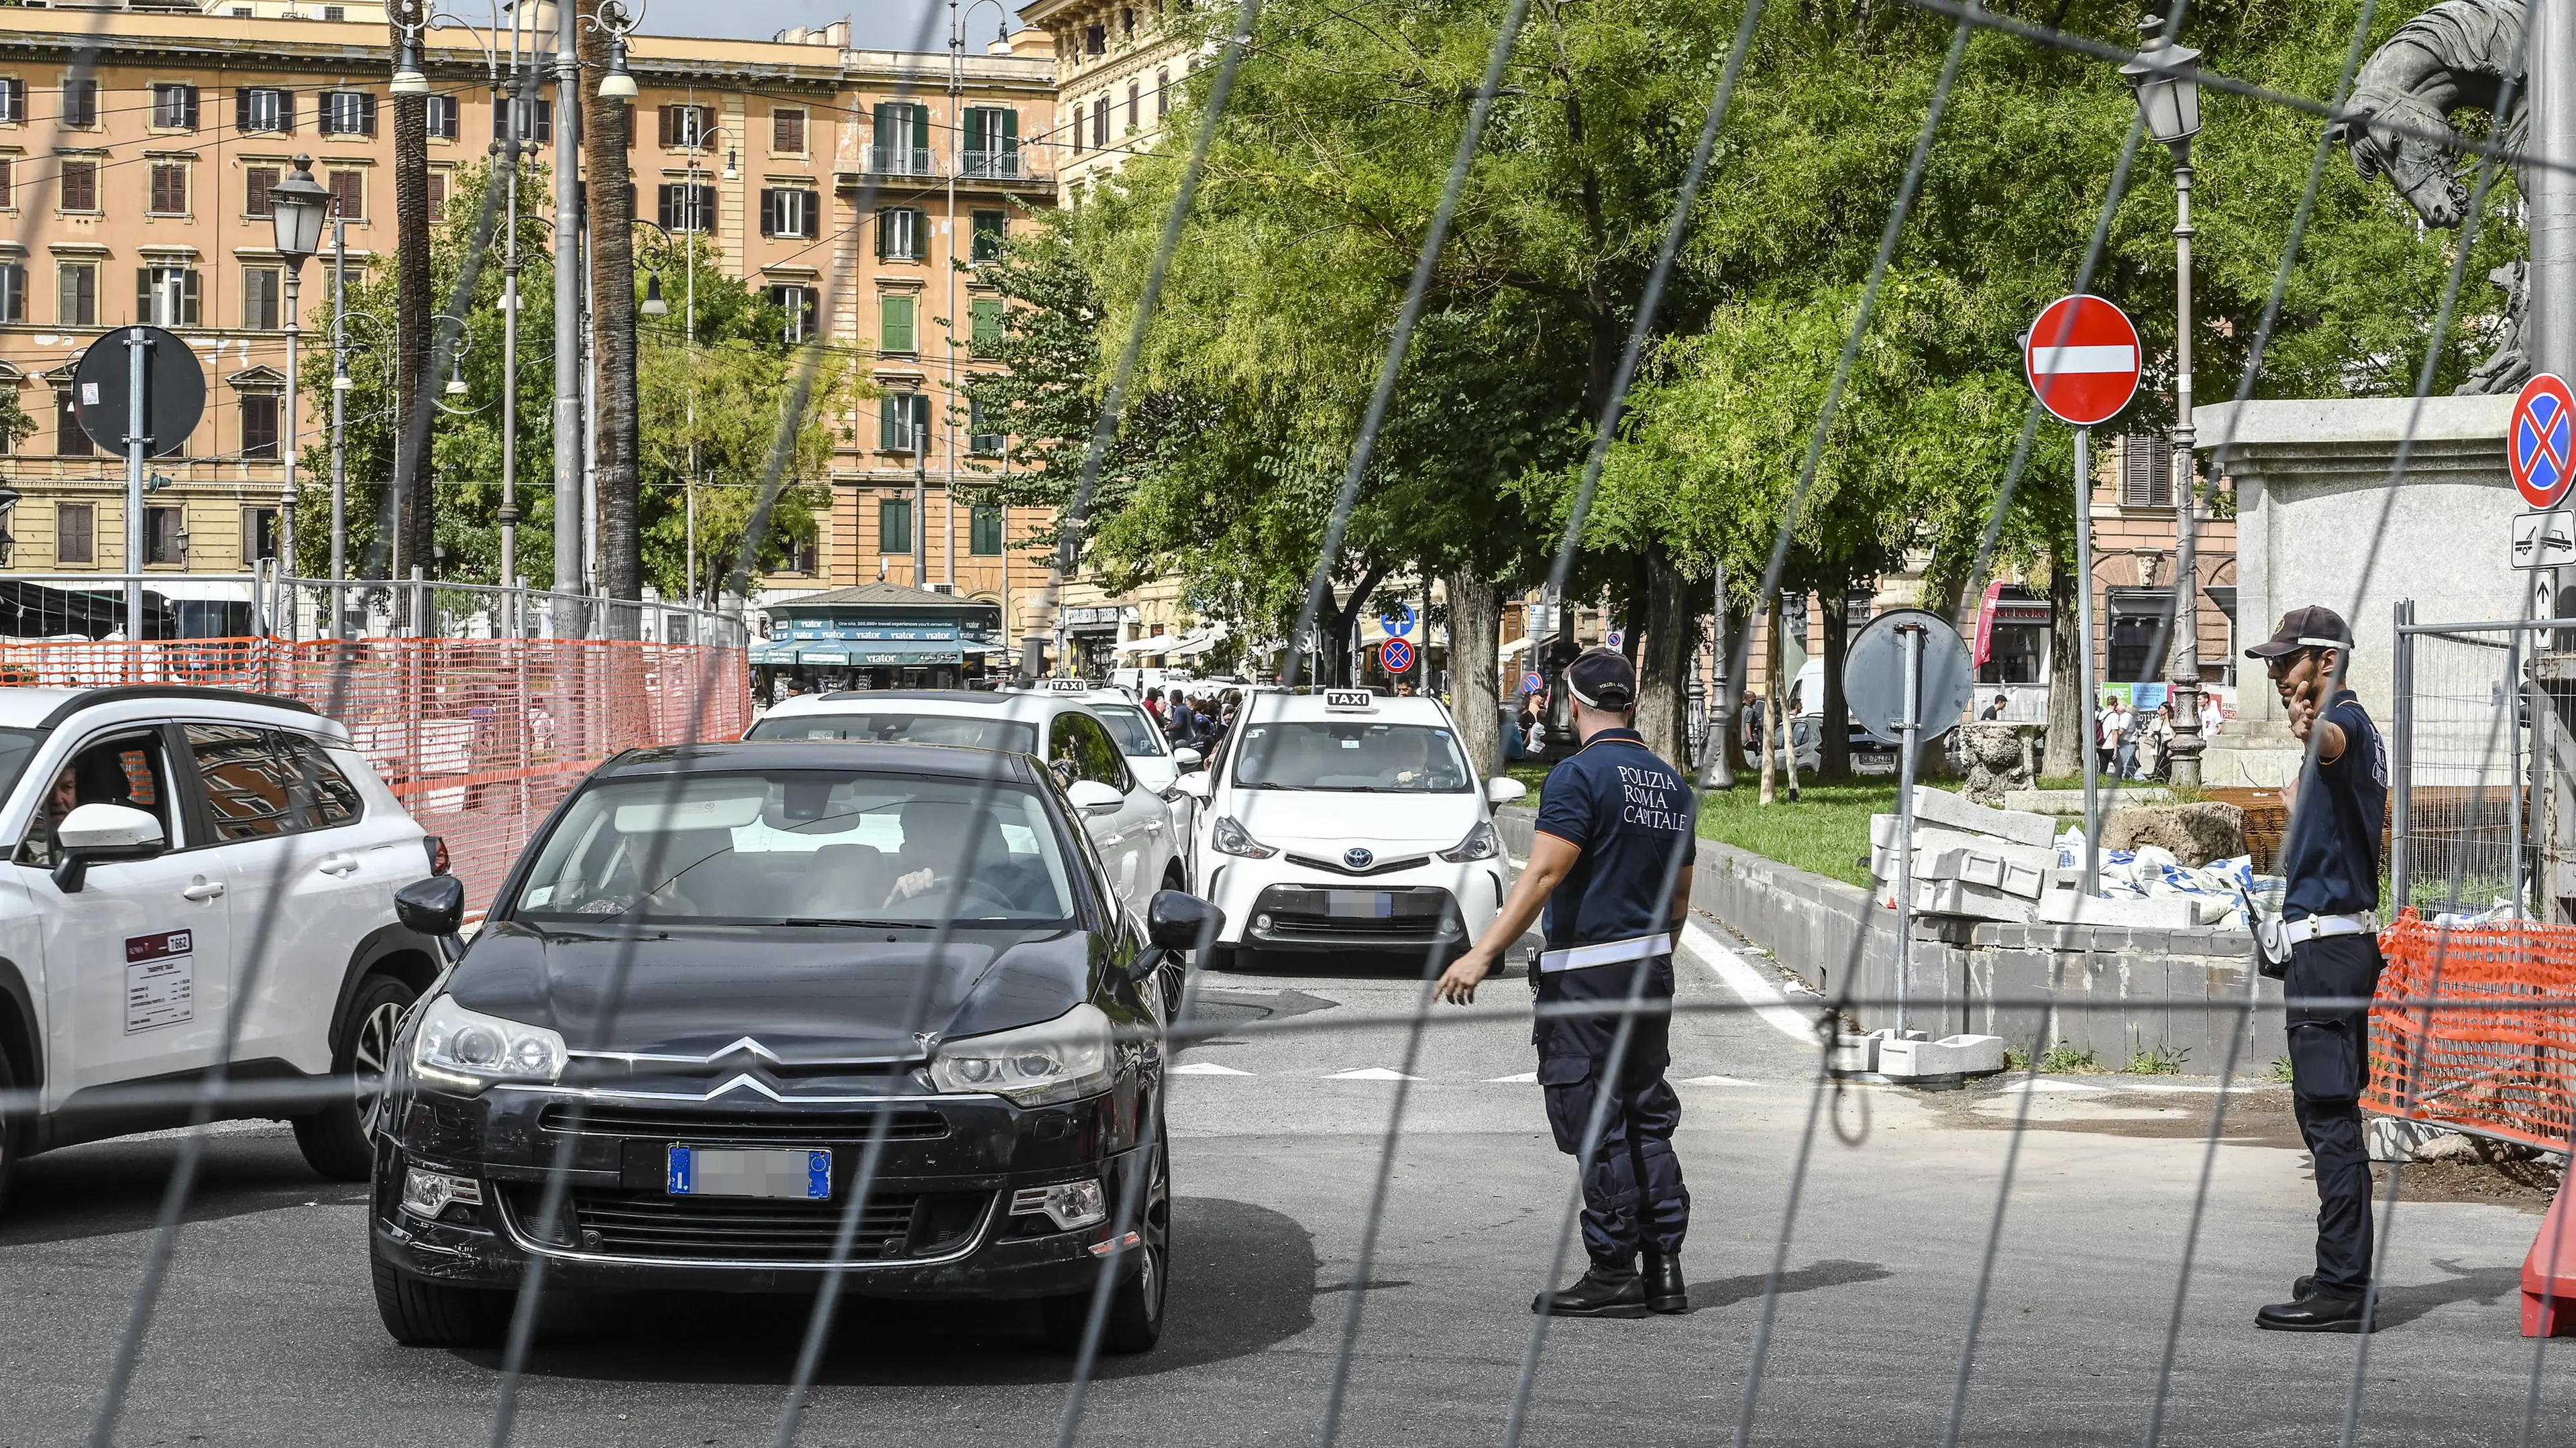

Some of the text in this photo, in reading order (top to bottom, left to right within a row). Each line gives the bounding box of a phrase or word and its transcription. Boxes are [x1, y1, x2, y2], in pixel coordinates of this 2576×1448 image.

[2013, 608, 2050, 618] Locker
[856, 631, 881, 639] viator
[891, 631, 916, 639] viator
[926, 631, 951, 639] viator
[866, 654, 897, 663] viator
[1053, 681, 1083, 690] TAXI
[1328, 694, 1368, 706] TAXI
[1617, 765, 1678, 791] POLIZIA
[1623, 784, 1669, 809] ROMA
[1623, 805, 1688, 831] CAPITALE
